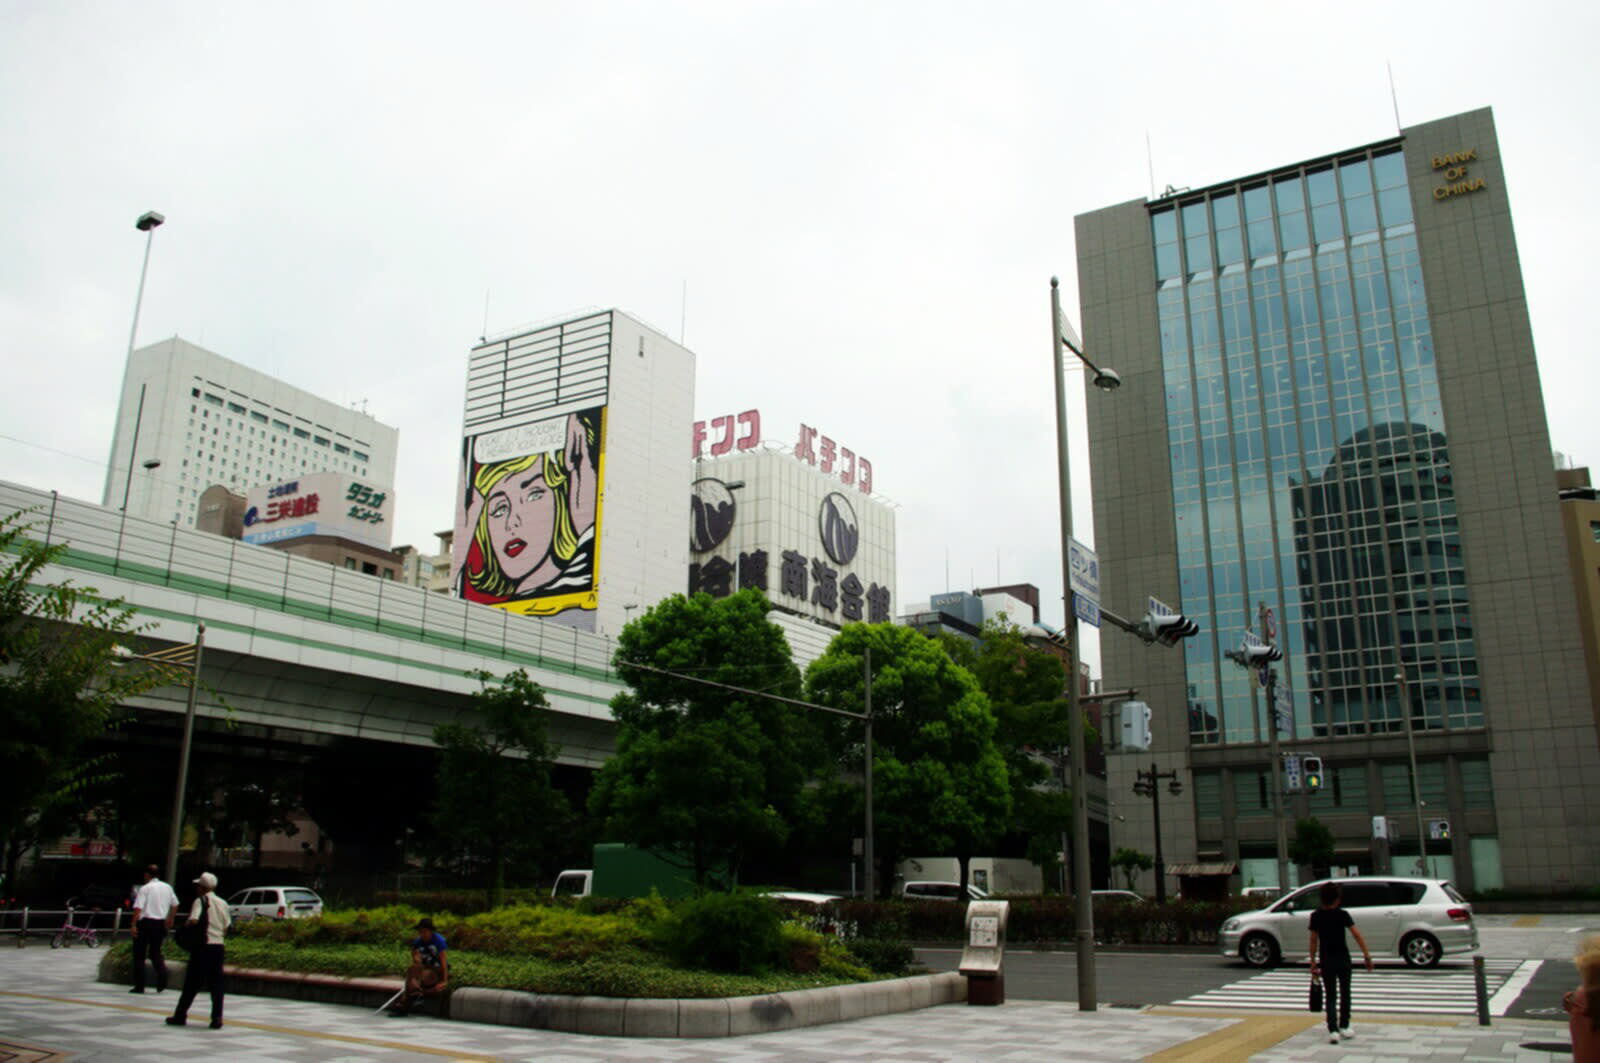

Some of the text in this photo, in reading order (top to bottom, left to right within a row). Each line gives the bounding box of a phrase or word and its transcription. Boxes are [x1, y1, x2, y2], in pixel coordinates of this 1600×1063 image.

[1432, 147, 1477, 169] BANK
[1445, 165, 1467, 180] OF
[1433, 177, 1486, 200] CHINA
